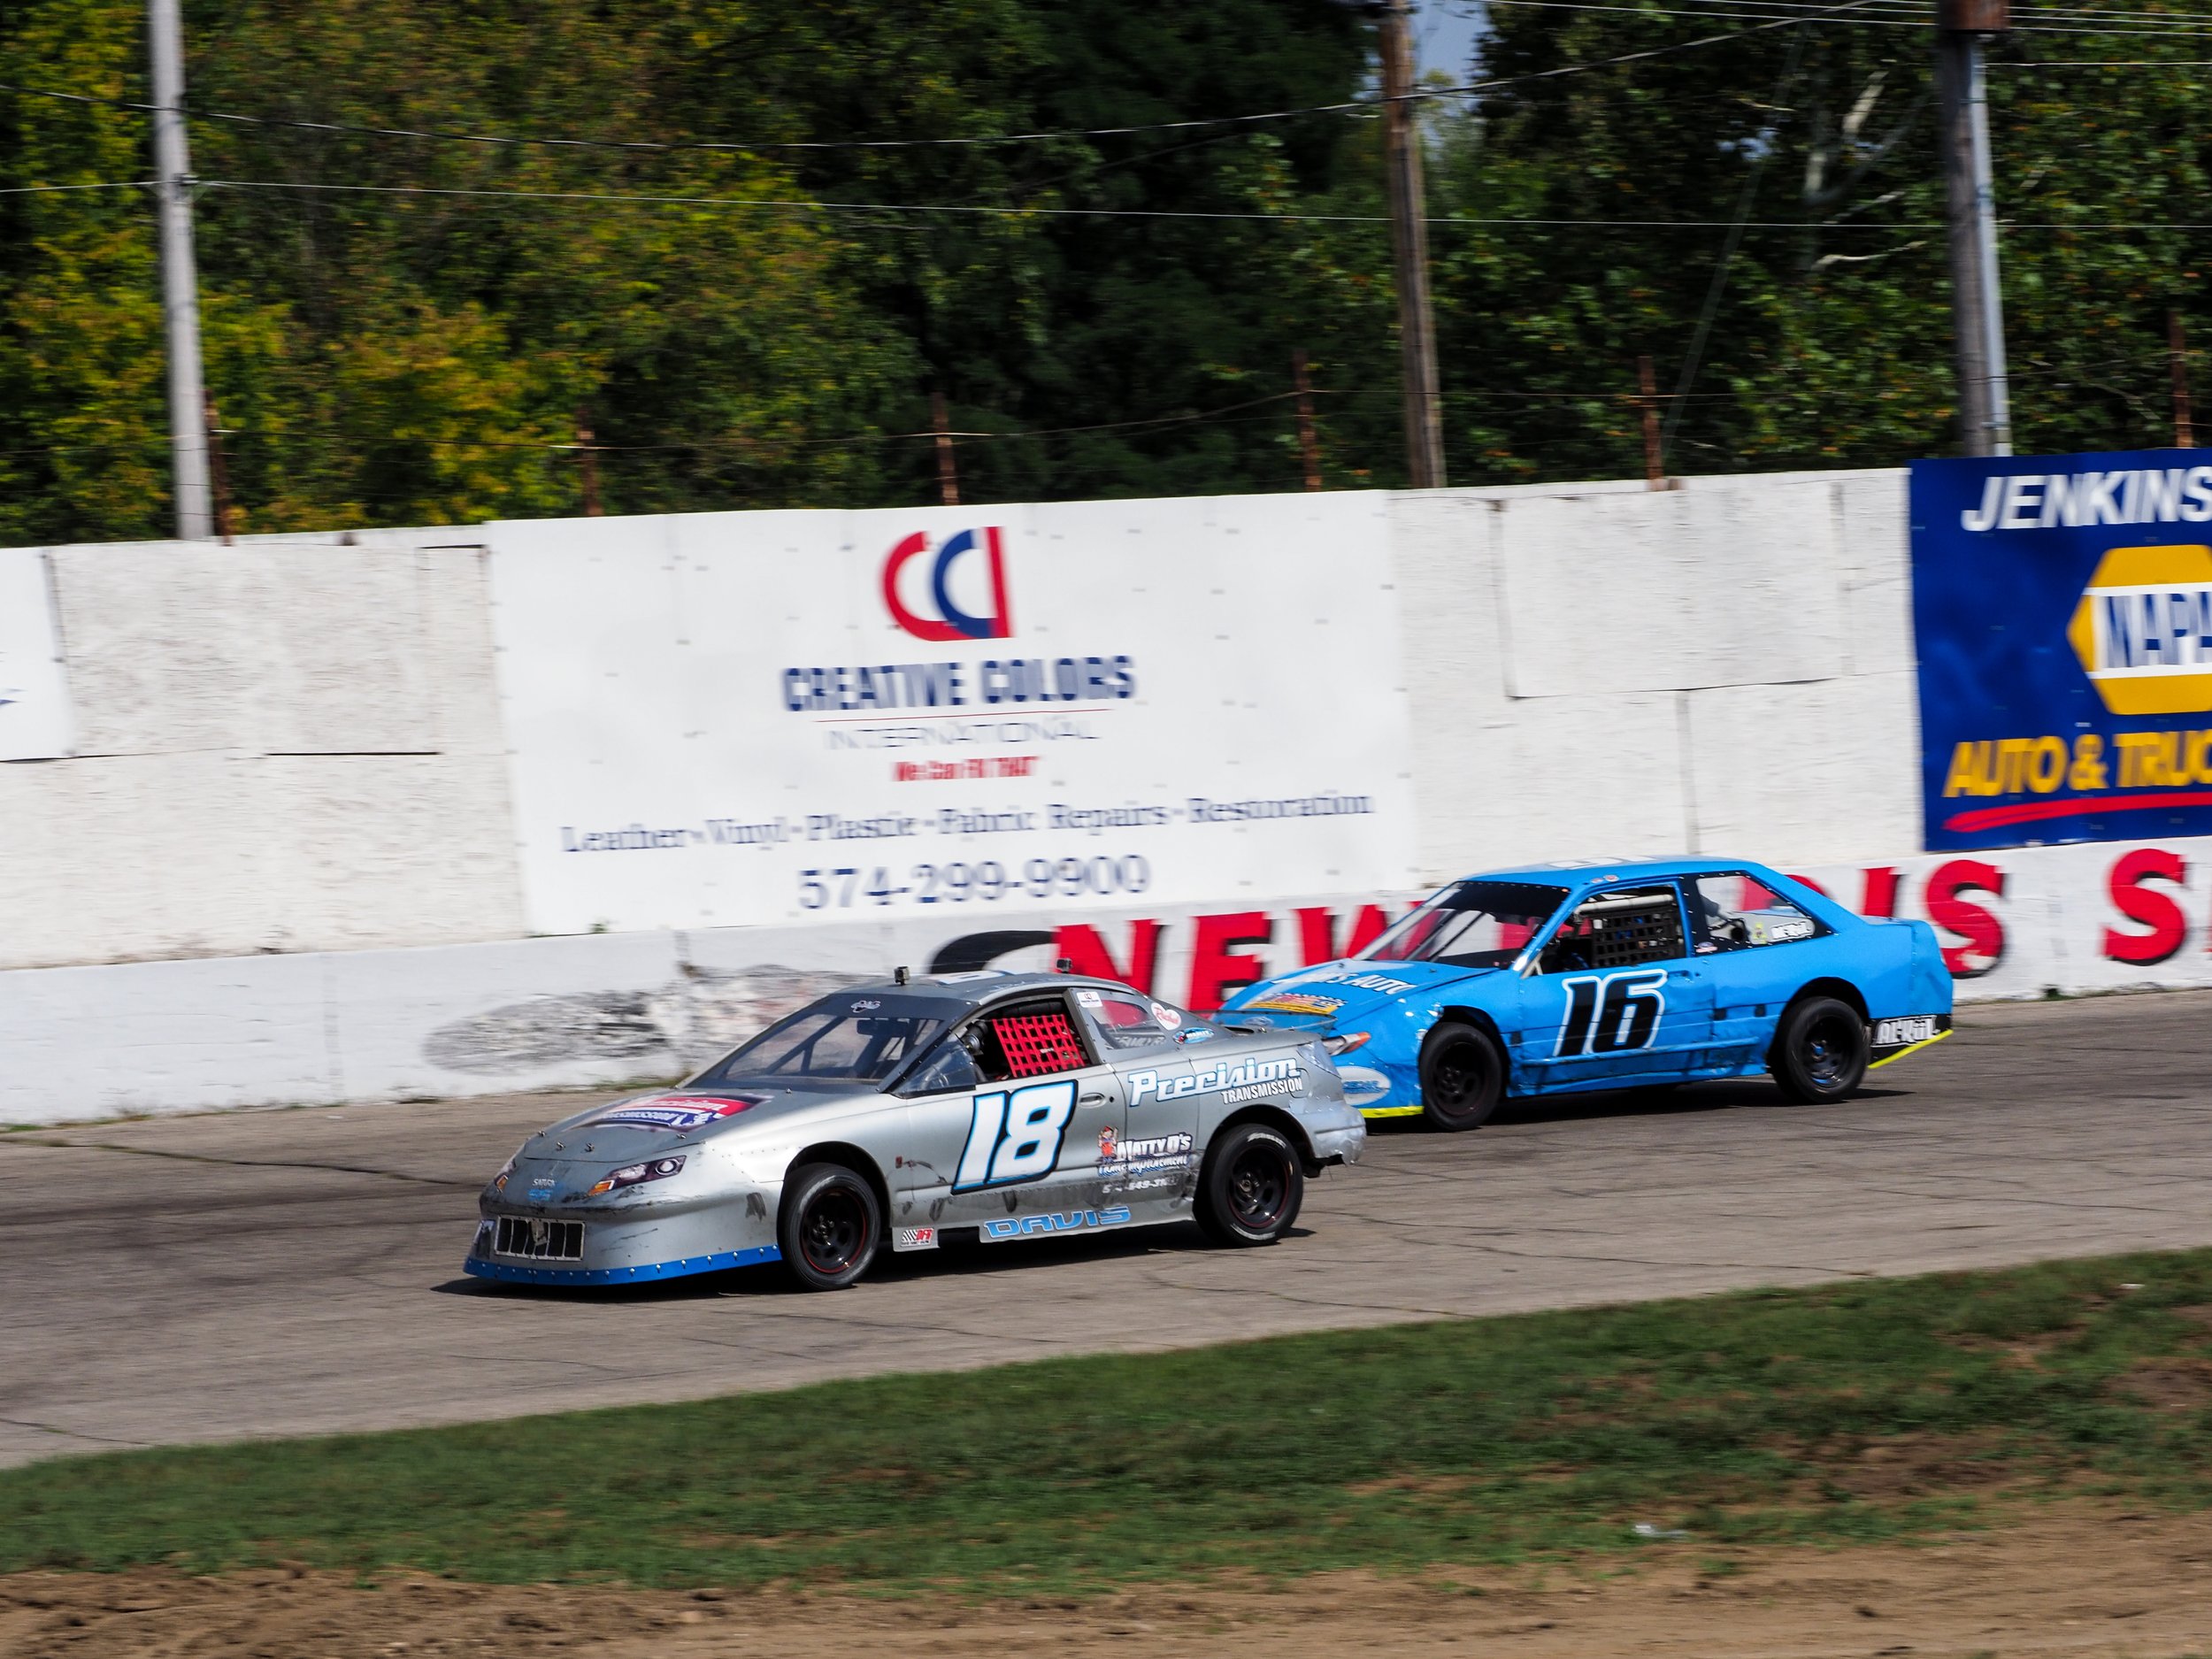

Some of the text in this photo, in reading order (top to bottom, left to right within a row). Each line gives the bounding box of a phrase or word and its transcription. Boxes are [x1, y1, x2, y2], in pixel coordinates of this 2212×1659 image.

[1961, 465, 2212, 531] JENKINS
[783, 655, 1137, 711] CREATIVE COLORS
[825, 718, 1102, 749] INTERNATIONAL
[1943, 736, 2069, 797] AUTO
[2069, 733, 2109, 790] &
[798, 855, 1150, 909] 574-299-9900
[1553, 969, 1668, 1056] 16
[1128, 1057, 1301, 1108] Precision
[1220, 1078, 1303, 1105] TRANSMISSION
[950, 1079, 1079, 1195] 18
[984, 1206, 1133, 1239] DAVIS
